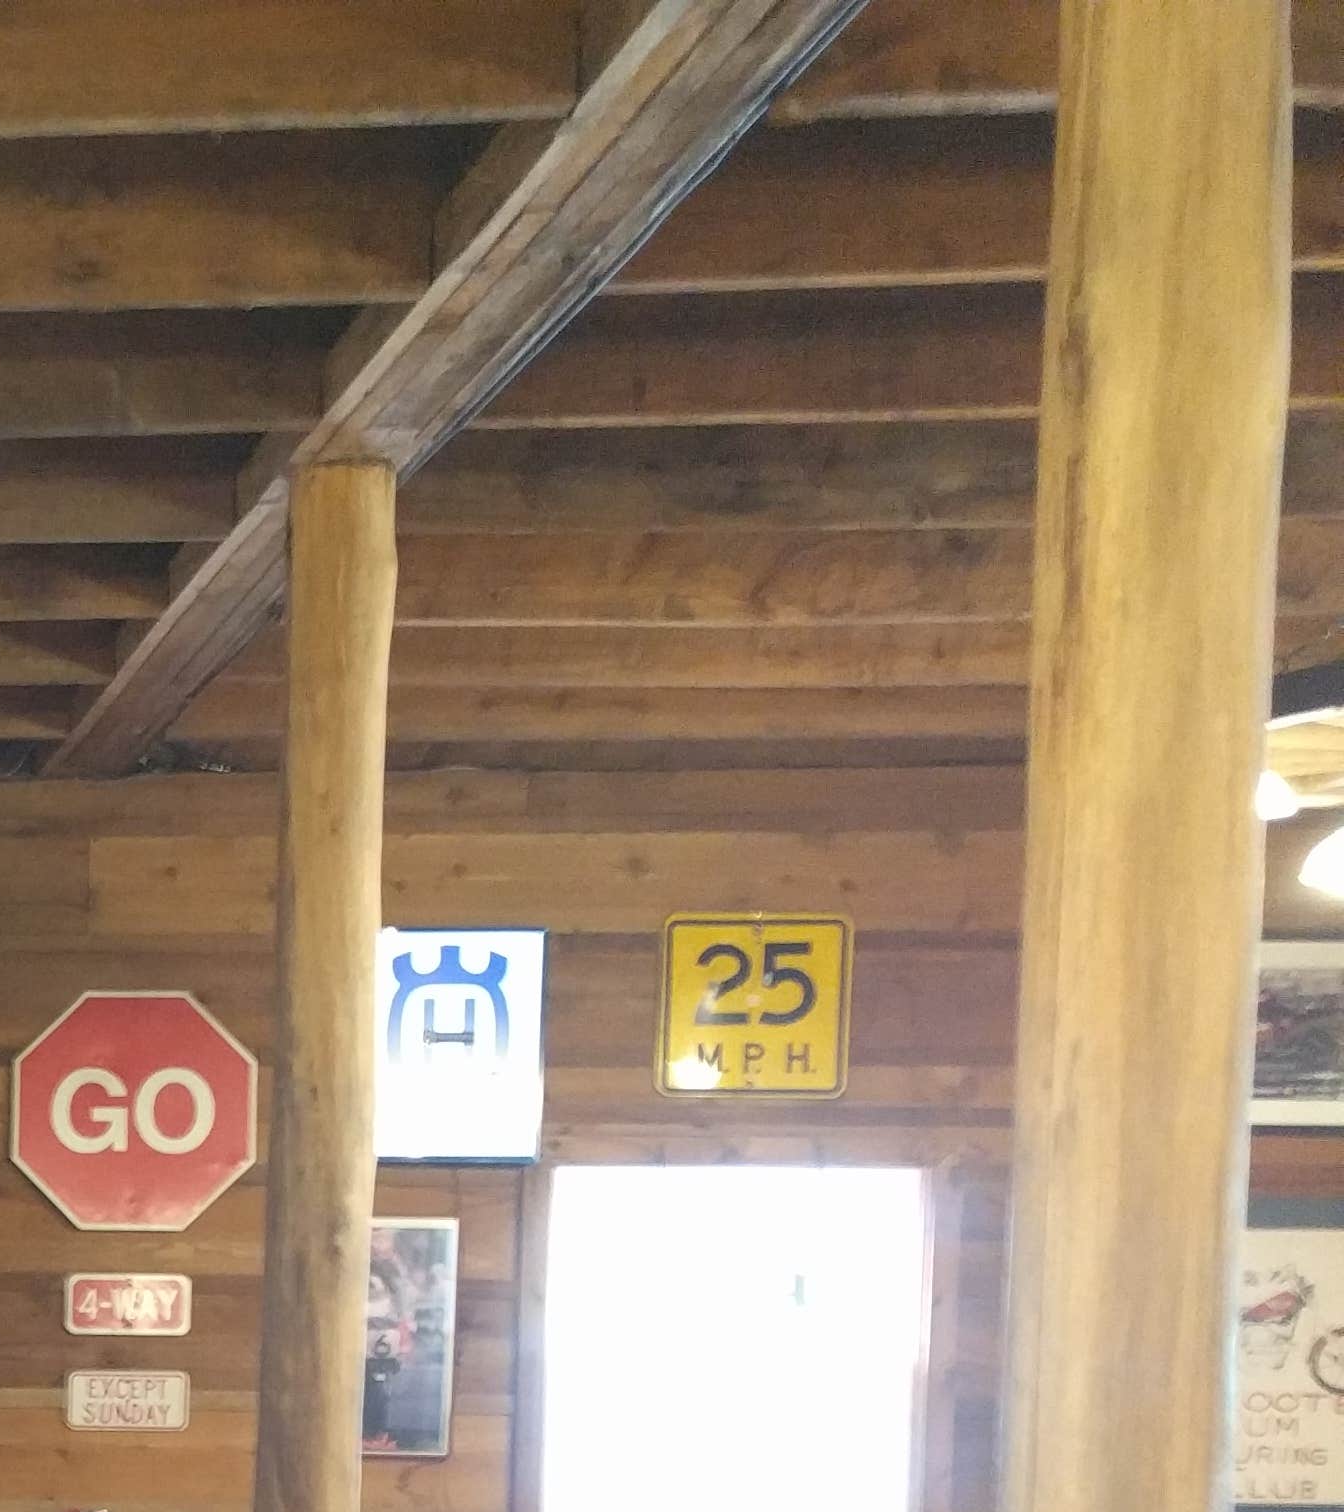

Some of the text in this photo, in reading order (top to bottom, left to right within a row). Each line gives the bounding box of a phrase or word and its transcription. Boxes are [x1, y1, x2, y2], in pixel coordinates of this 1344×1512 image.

[695, 942, 817, 1026] 25
[50, 1066, 216, 1155] GO
[77, 1288, 179, 1321] 4-WAY
[88, 1378, 168, 1399] EXCEPT
[82, 1402, 173, 1424] SUNDAY
